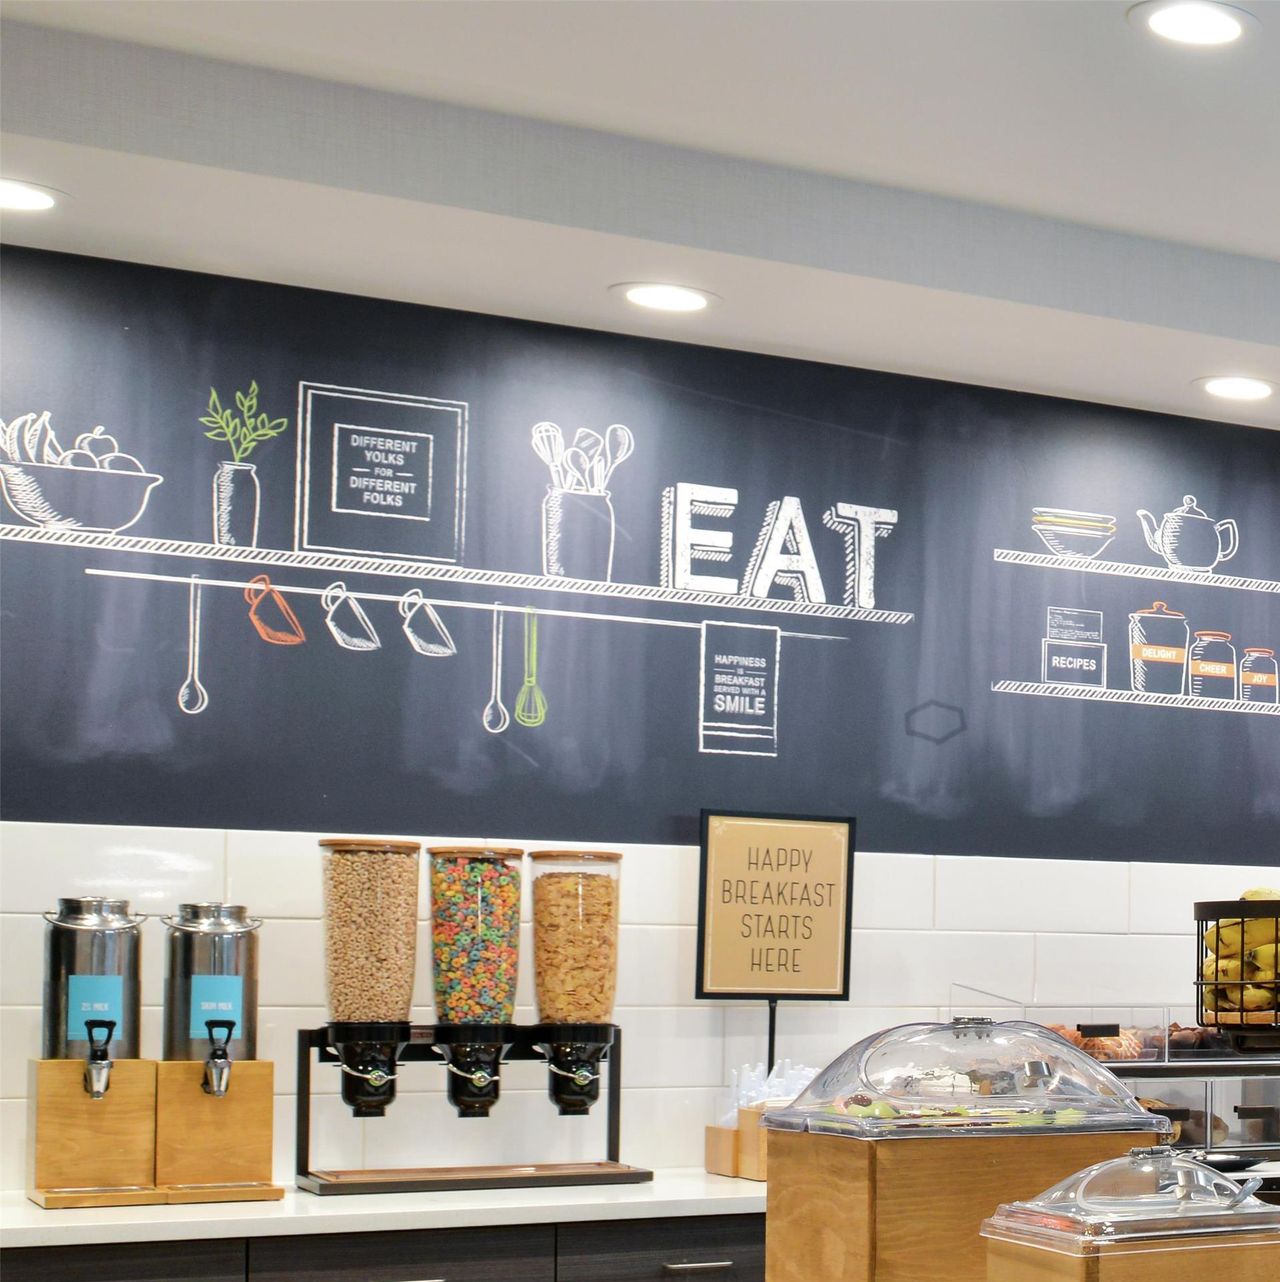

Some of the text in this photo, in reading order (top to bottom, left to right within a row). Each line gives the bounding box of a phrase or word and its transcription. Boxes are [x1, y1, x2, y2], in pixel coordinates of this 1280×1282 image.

[350, 434, 418, 453] DIFFERENT
[364, 450, 405, 465] YOLKS
[374, 467, 394, 477] FOR
[349, 476, 417, 494] DIFFERENT
[363, 491, 403, 507] FOLKS
[660, 482, 899, 609] EAT
[1141, 647, 1177, 659] DELIGHT
[714, 654, 767, 668] HAPPINESS
[1051, 656, 1097, 671] RECIPES
[1199, 664, 1228, 675] CHEER
[714, 674, 765, 687] BREAKFAST
[1252, 675, 1268, 683] JOY
[713, 685, 767, 696] SERVED WITH A
[713, 694, 766, 715] SMILE
[747, 846, 813, 873] HAPPY
[721, 879, 836, 907] BREAKFAST
[740, 913, 814, 940] STARTS
[751, 947, 802, 973] HERE
